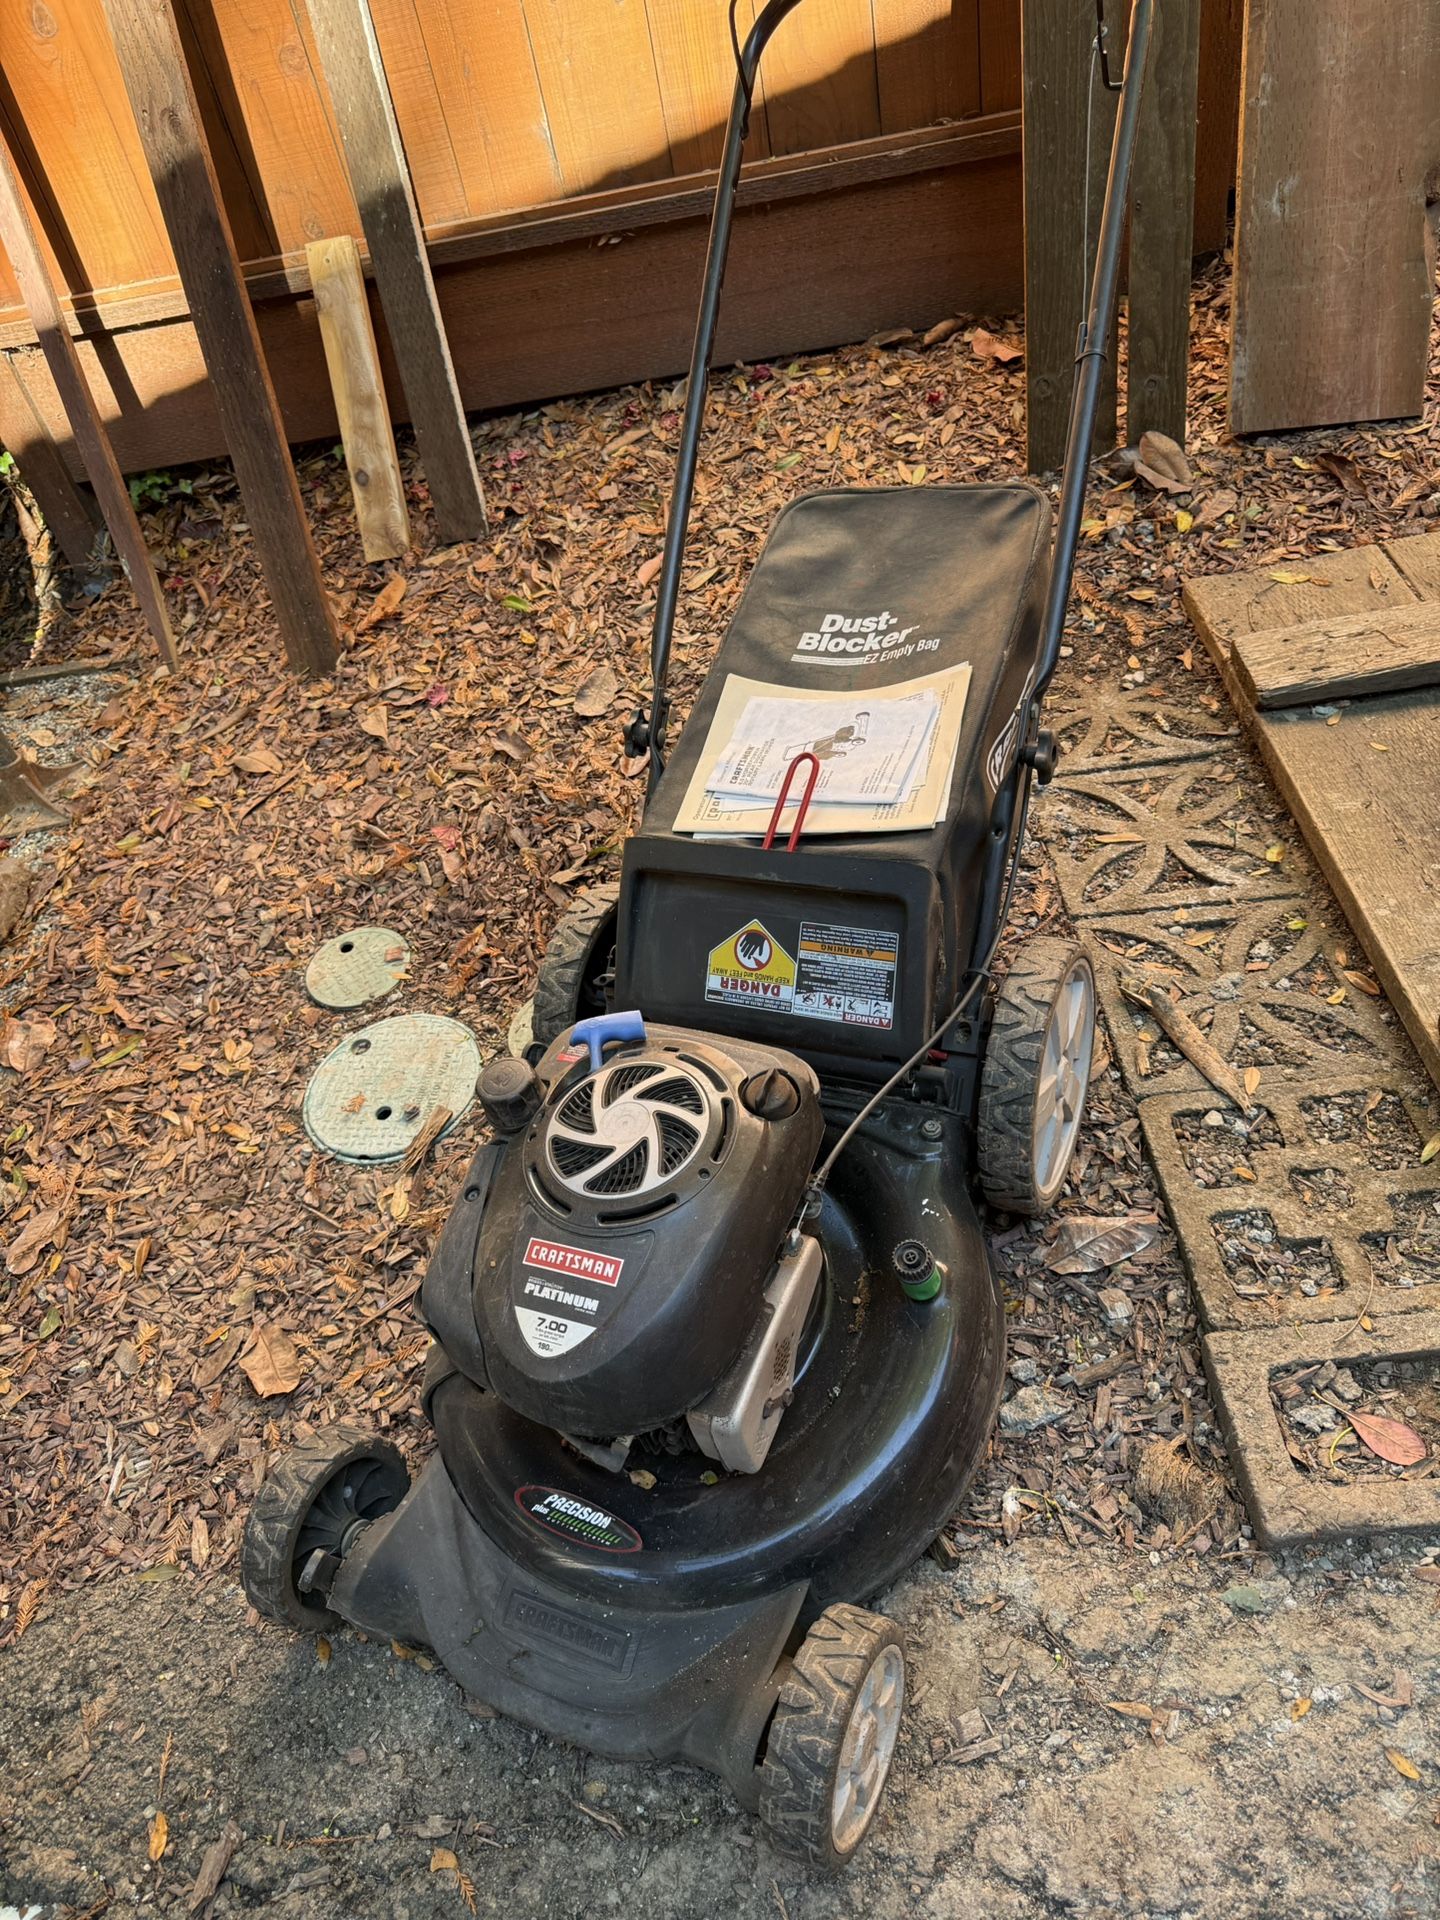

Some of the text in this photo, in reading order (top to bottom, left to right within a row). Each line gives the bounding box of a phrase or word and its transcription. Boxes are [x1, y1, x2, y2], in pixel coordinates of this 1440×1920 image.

[820, 611, 898, 633] Dust-
[797, 626, 914, 652] Blocker
[863, 638, 941, 664] EZ Empty Bag
[729, 746, 755, 785] CRAFTSMAN
[821, 944, 863, 955] WARNING
[712, 967, 728, 975] AWAY
[729, 969, 743, 977] FEET
[754, 972, 775, 981] HANDS
[775, 976, 790, 984] KEEP
[720, 976, 781, 997] DANGER
[845, 1012, 880, 1025] DANGER
[531, 1245, 615, 1278] CRAFTSMAN
[524, 1282, 600, 1312] PLATINUM
[537, 1317, 568, 1334] 7.00
[531, 1504, 550, 1516] plus
[543, 1494, 613, 1529] PRECISION
[547, 1517, 611, 1546] CUTTING SYSTEM
[516, 1604, 618, 1657] CRAFTSMAN
